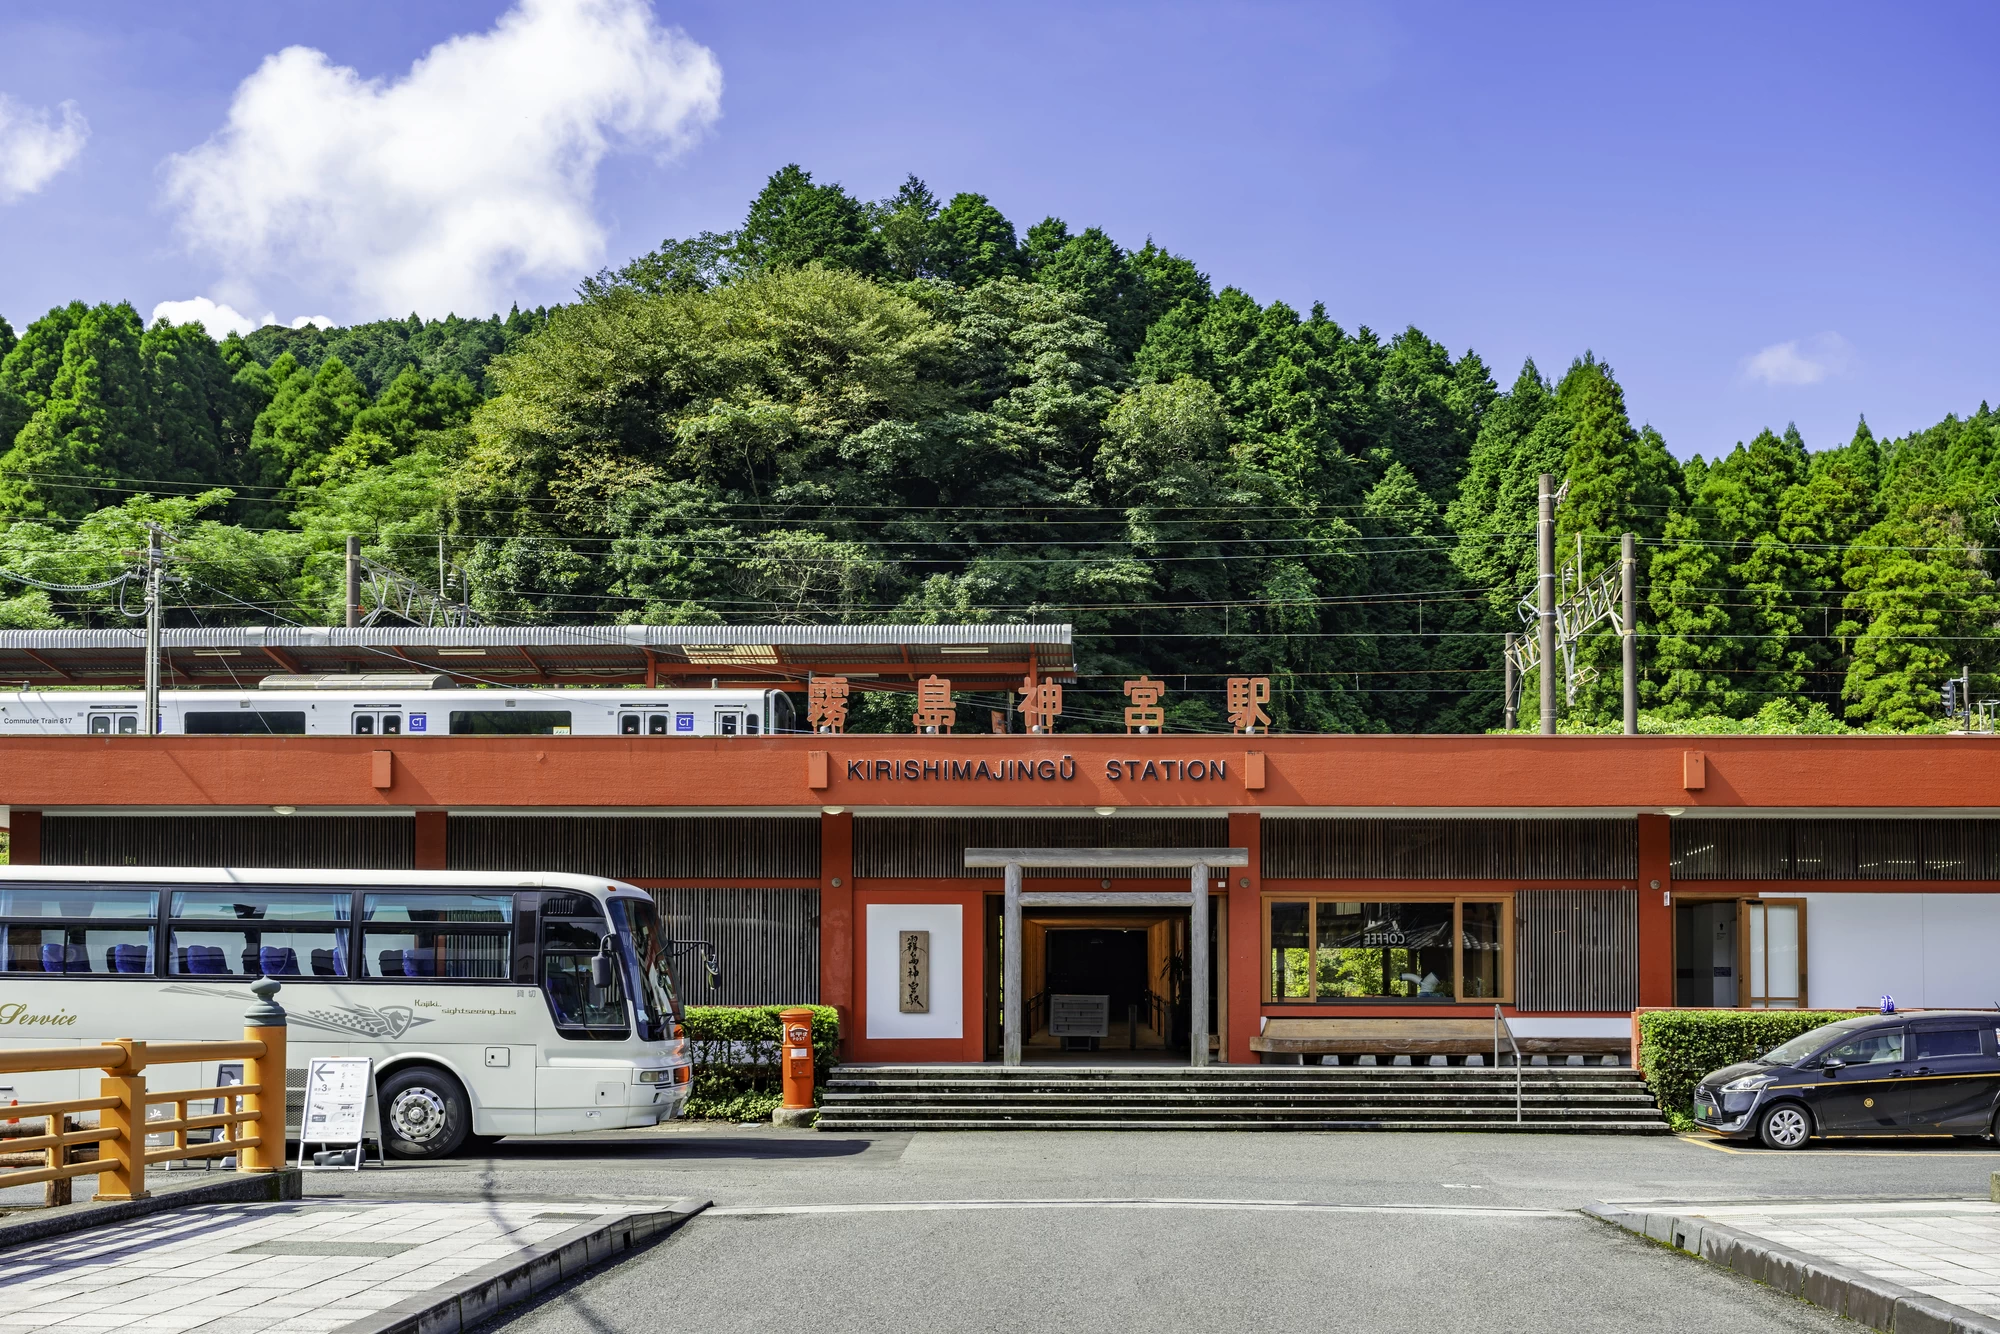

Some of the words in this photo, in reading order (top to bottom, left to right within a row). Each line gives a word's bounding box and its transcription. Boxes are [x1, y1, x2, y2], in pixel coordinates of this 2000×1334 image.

[806, 674, 1271, 728] 霧島神宮駅
[411, 717, 424, 727] CT
[679, 717, 691, 726] CT
[847, 754, 1076, 781] KIRISHIMAJINGŪ
[1105, 759, 1227, 781] STATION
[0, 1003, 77, 1026] Service
